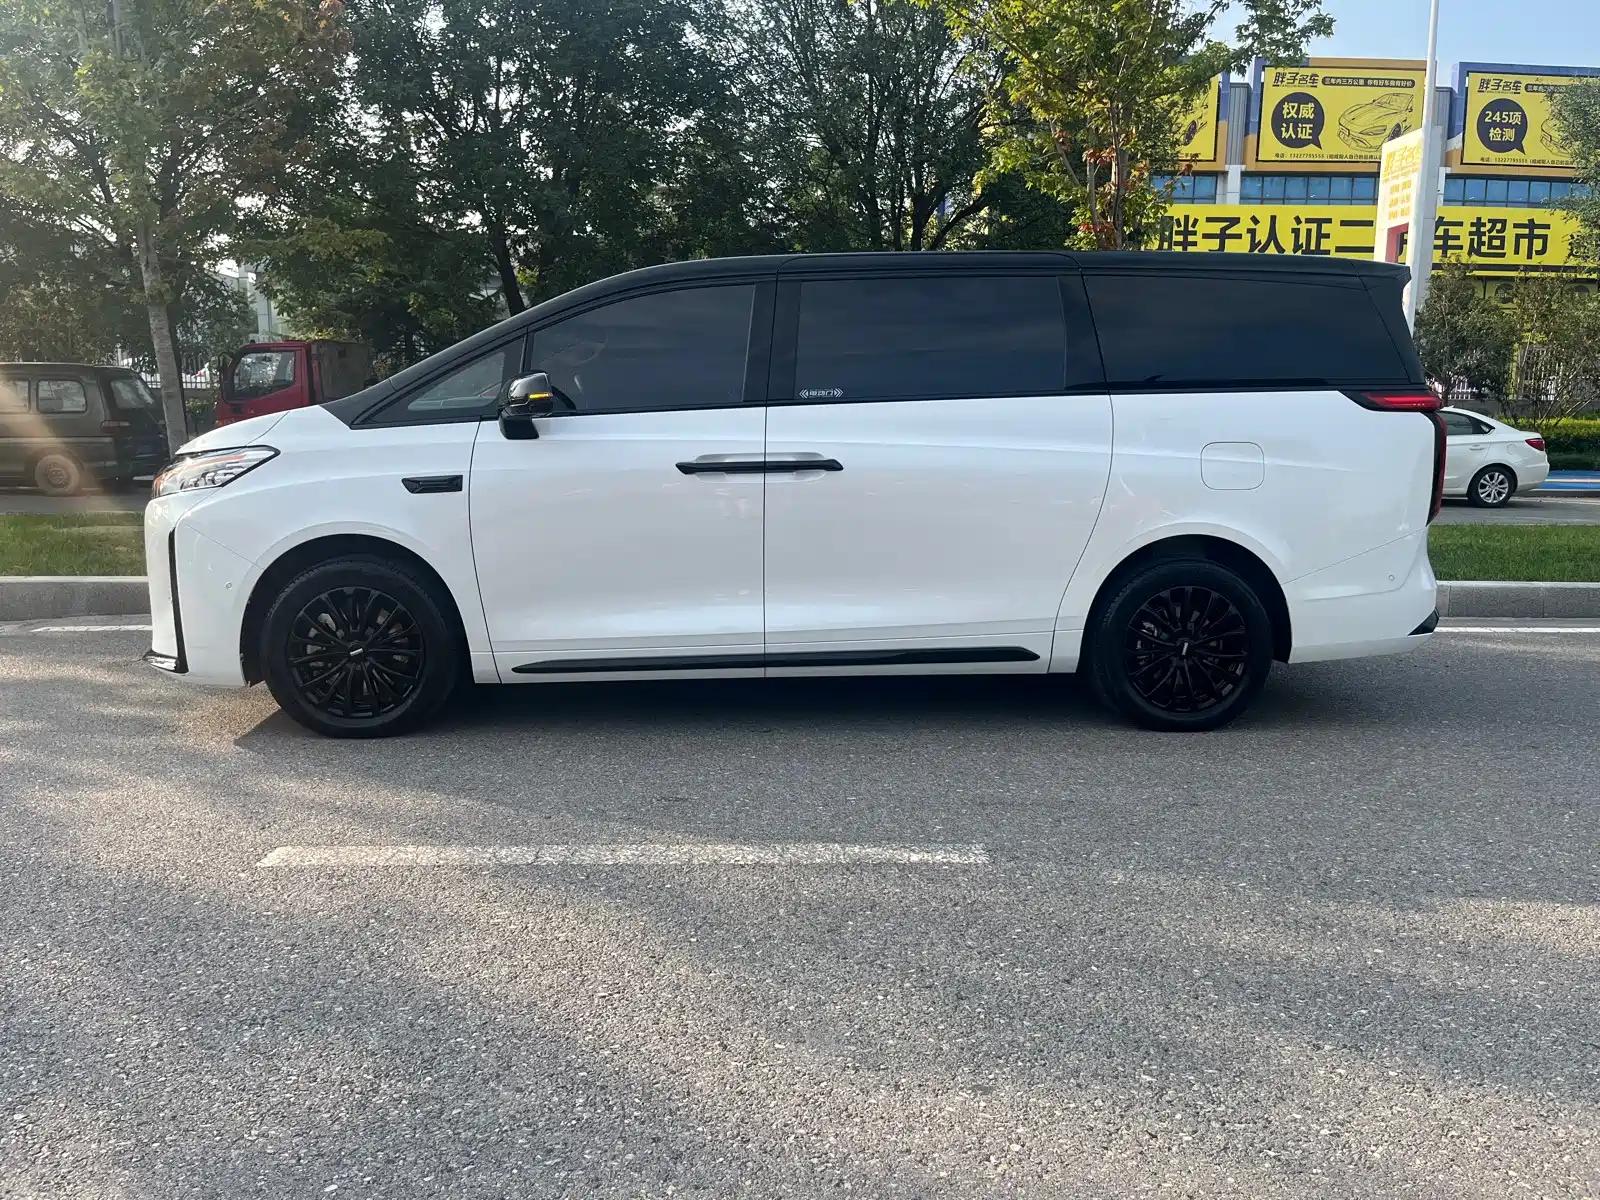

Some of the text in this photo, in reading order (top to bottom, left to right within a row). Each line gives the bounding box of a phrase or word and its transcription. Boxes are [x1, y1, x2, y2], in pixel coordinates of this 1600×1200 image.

[1273, 71, 1319, 85] 胖子名车
[1478, 78, 1522, 91] 胖子名车
[1282, 102, 1314, 119] 权威
[1484, 111, 1522, 125] 245项
[1280, 123, 1313, 140] 认证
[1489, 127, 1516, 142] 检测
[1157, 214, 1552, 259] 胖子认证二车超市
